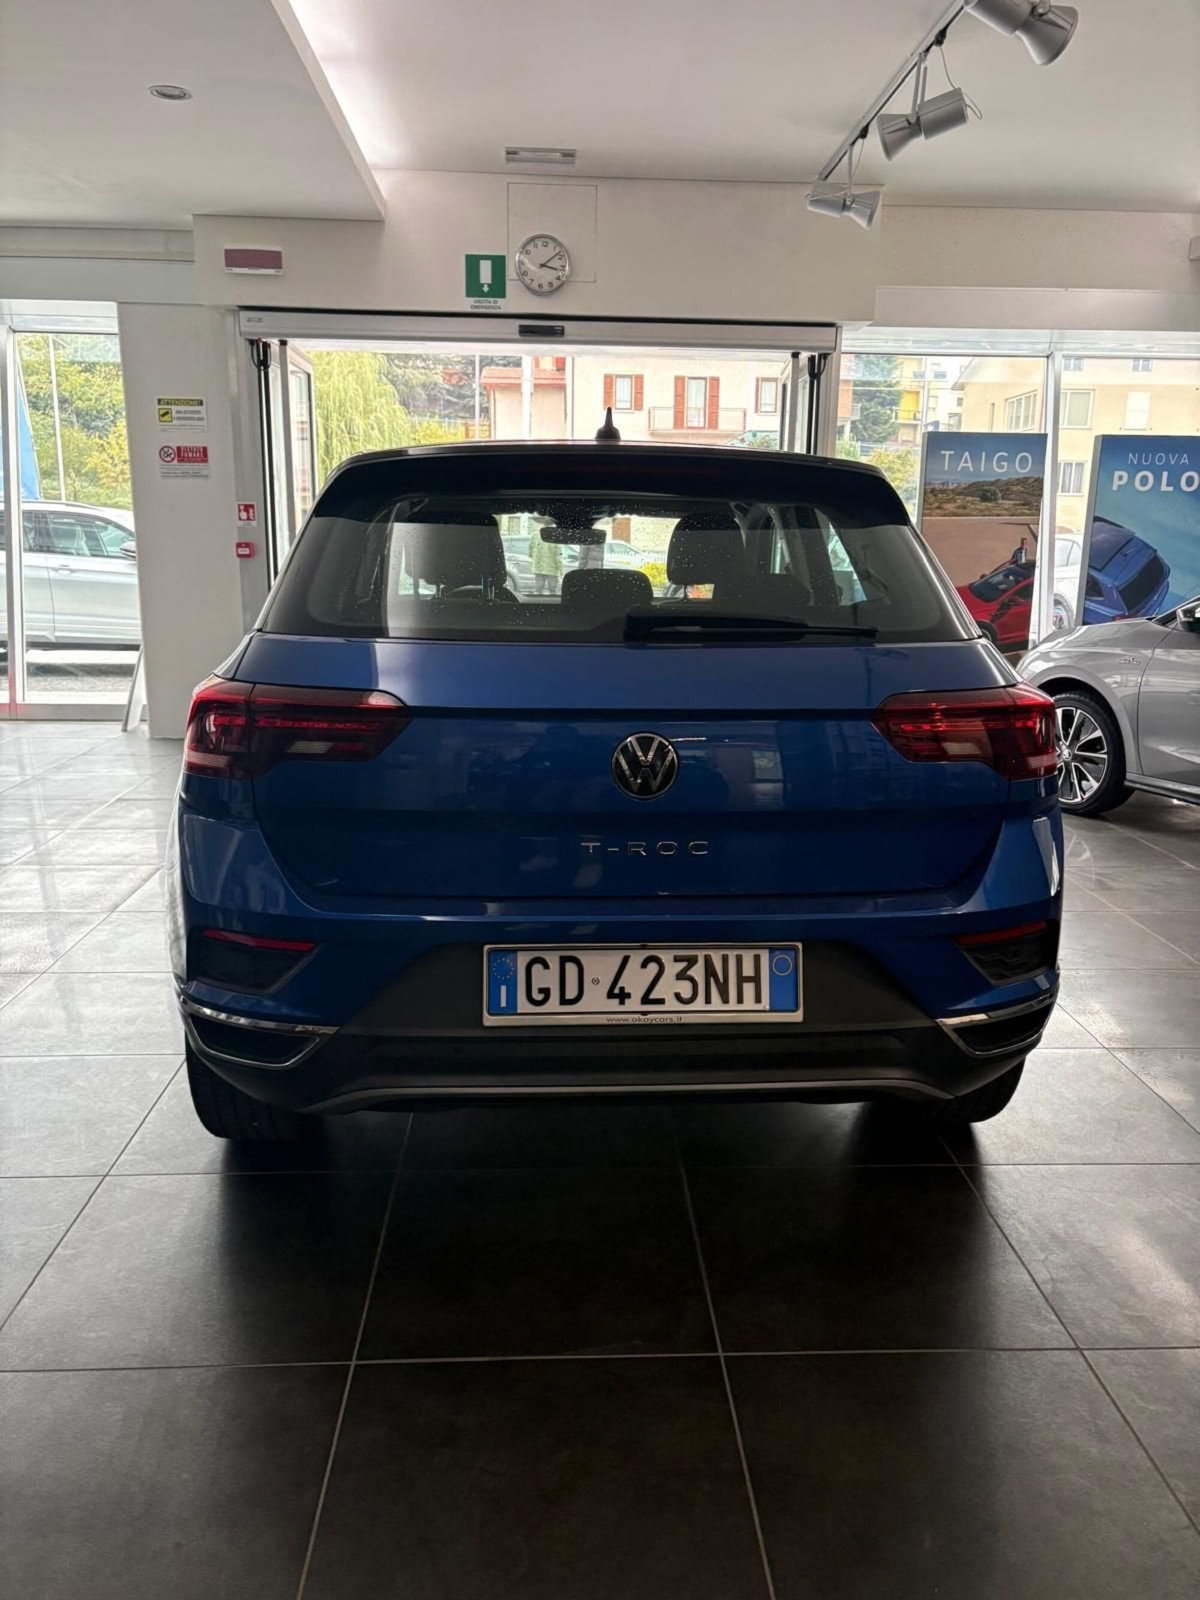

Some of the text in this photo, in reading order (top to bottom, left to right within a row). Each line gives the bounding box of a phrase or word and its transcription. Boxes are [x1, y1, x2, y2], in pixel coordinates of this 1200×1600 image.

[940, 450, 1033, 473] TAIGO
[1128, 452, 1189, 466] NUOVA
[1112, 470, 1200, 492] POLO
[580, 840, 709, 856] T-ROC
[524, 953, 763, 1007] GD 423NH
[606, 1015, 683, 1025] www.okaycars.it
